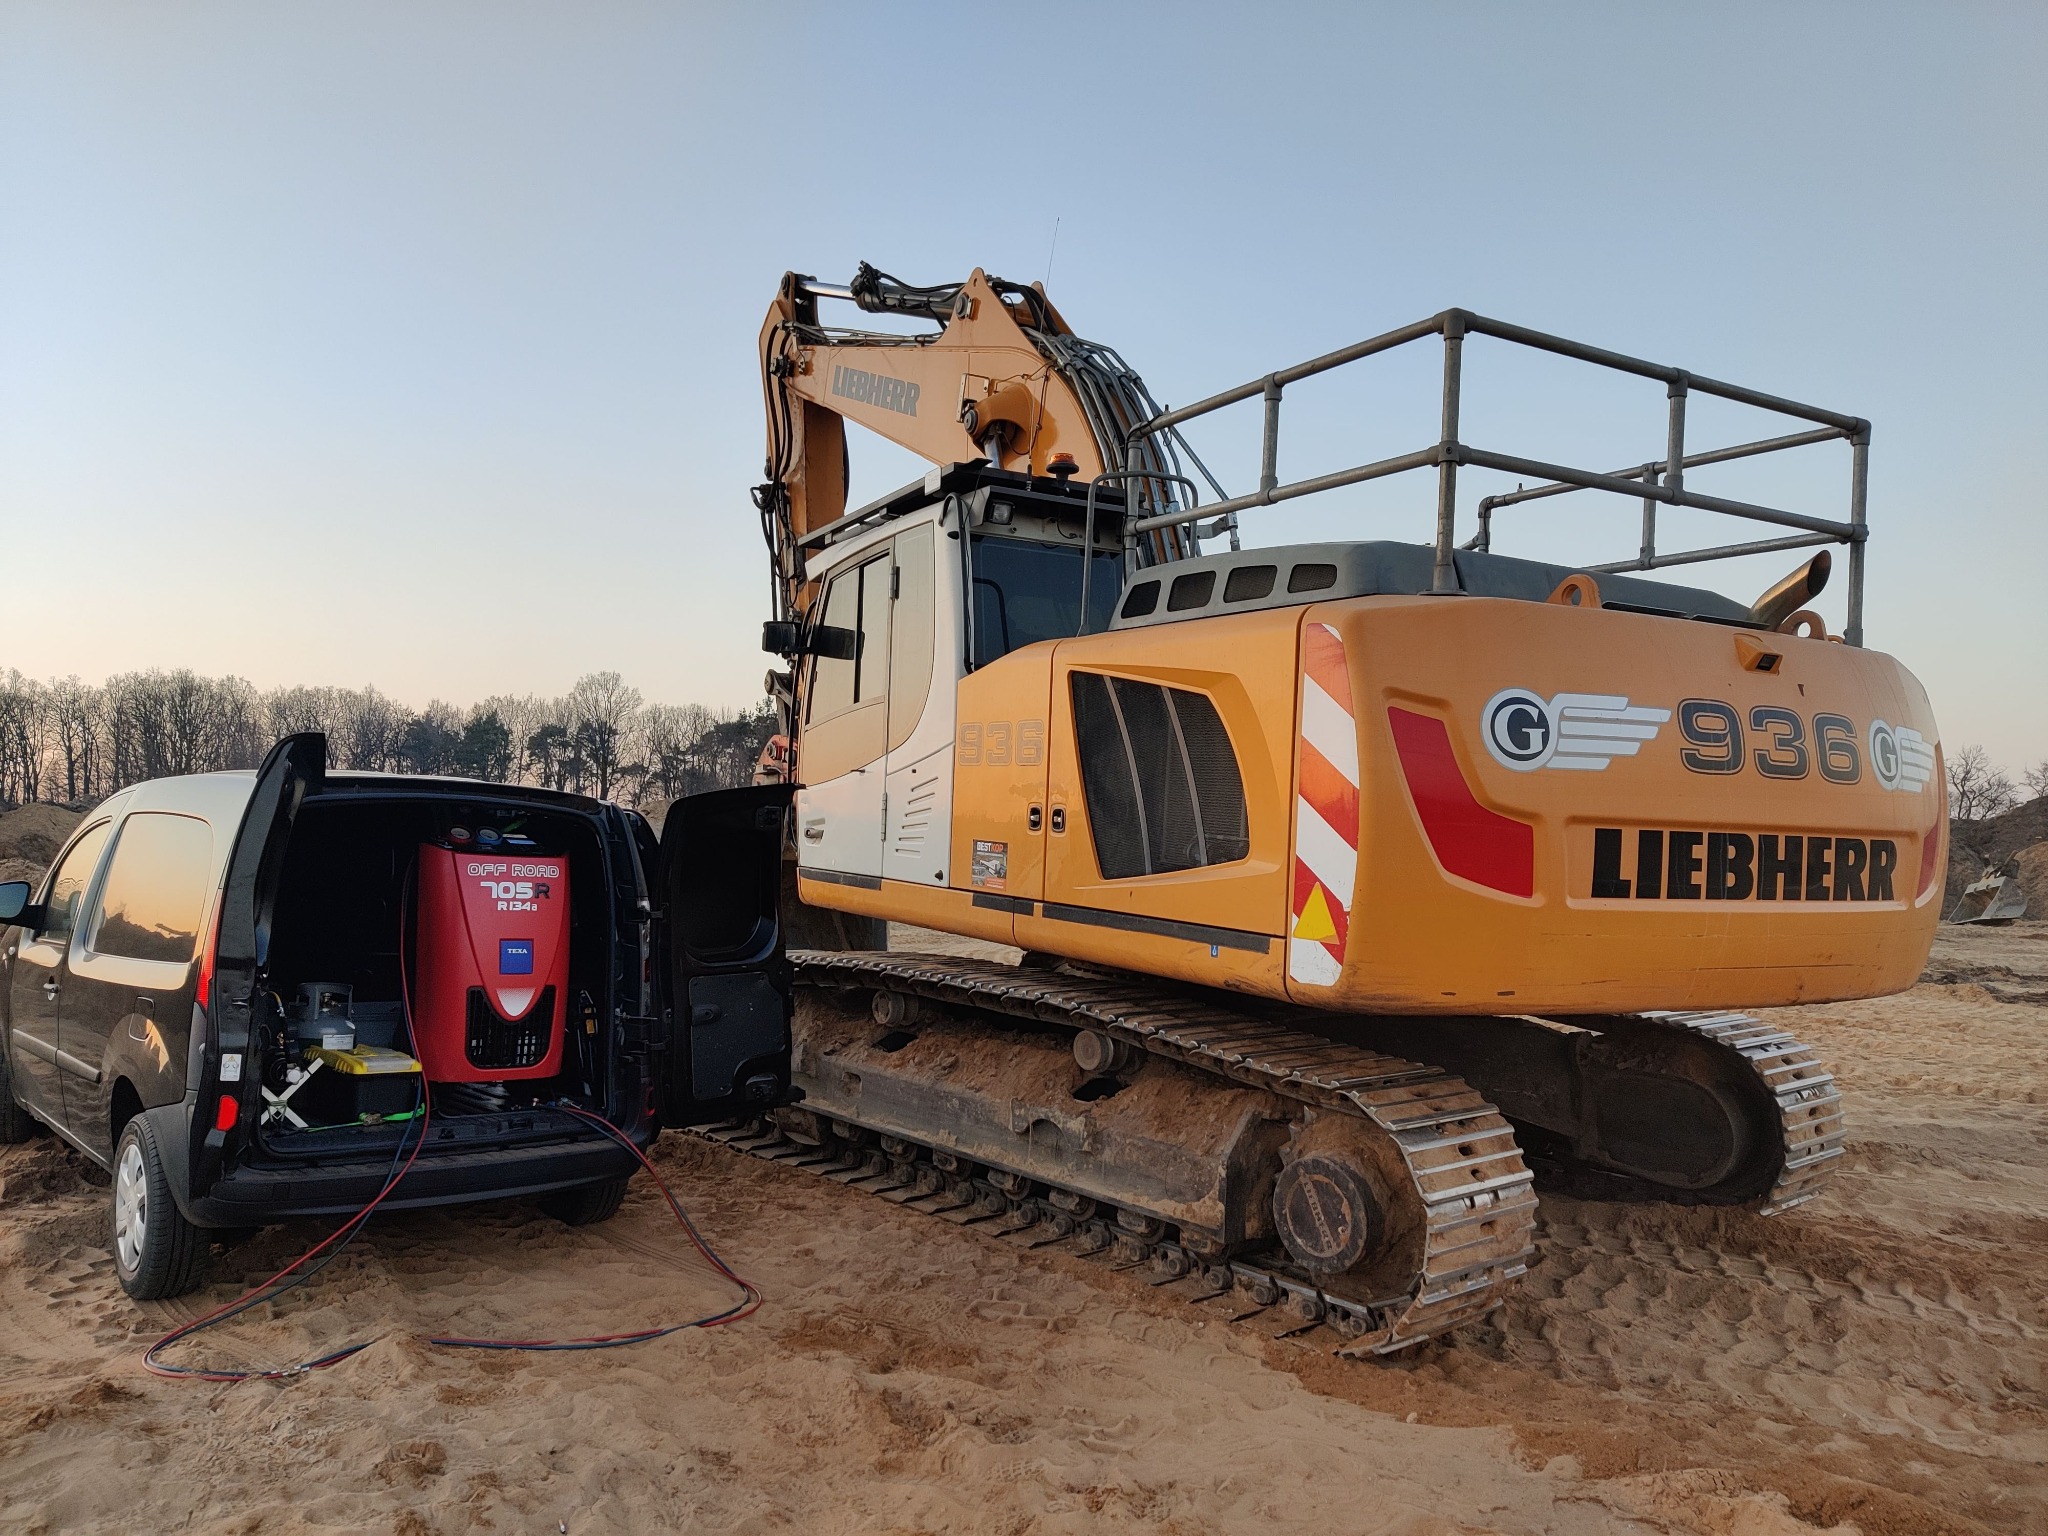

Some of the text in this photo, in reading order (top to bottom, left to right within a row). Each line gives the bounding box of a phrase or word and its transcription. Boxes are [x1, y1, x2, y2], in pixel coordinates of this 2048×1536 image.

[832, 365, 920, 417] LIEBHERR
[958, 719, 1044, 766] 936
[1677, 697, 1862, 785] 936
[467, 863, 559, 878] OFF ROAD
[1591, 828, 1897, 901] LIEBHERR
[480, 881, 550, 899] 705R
